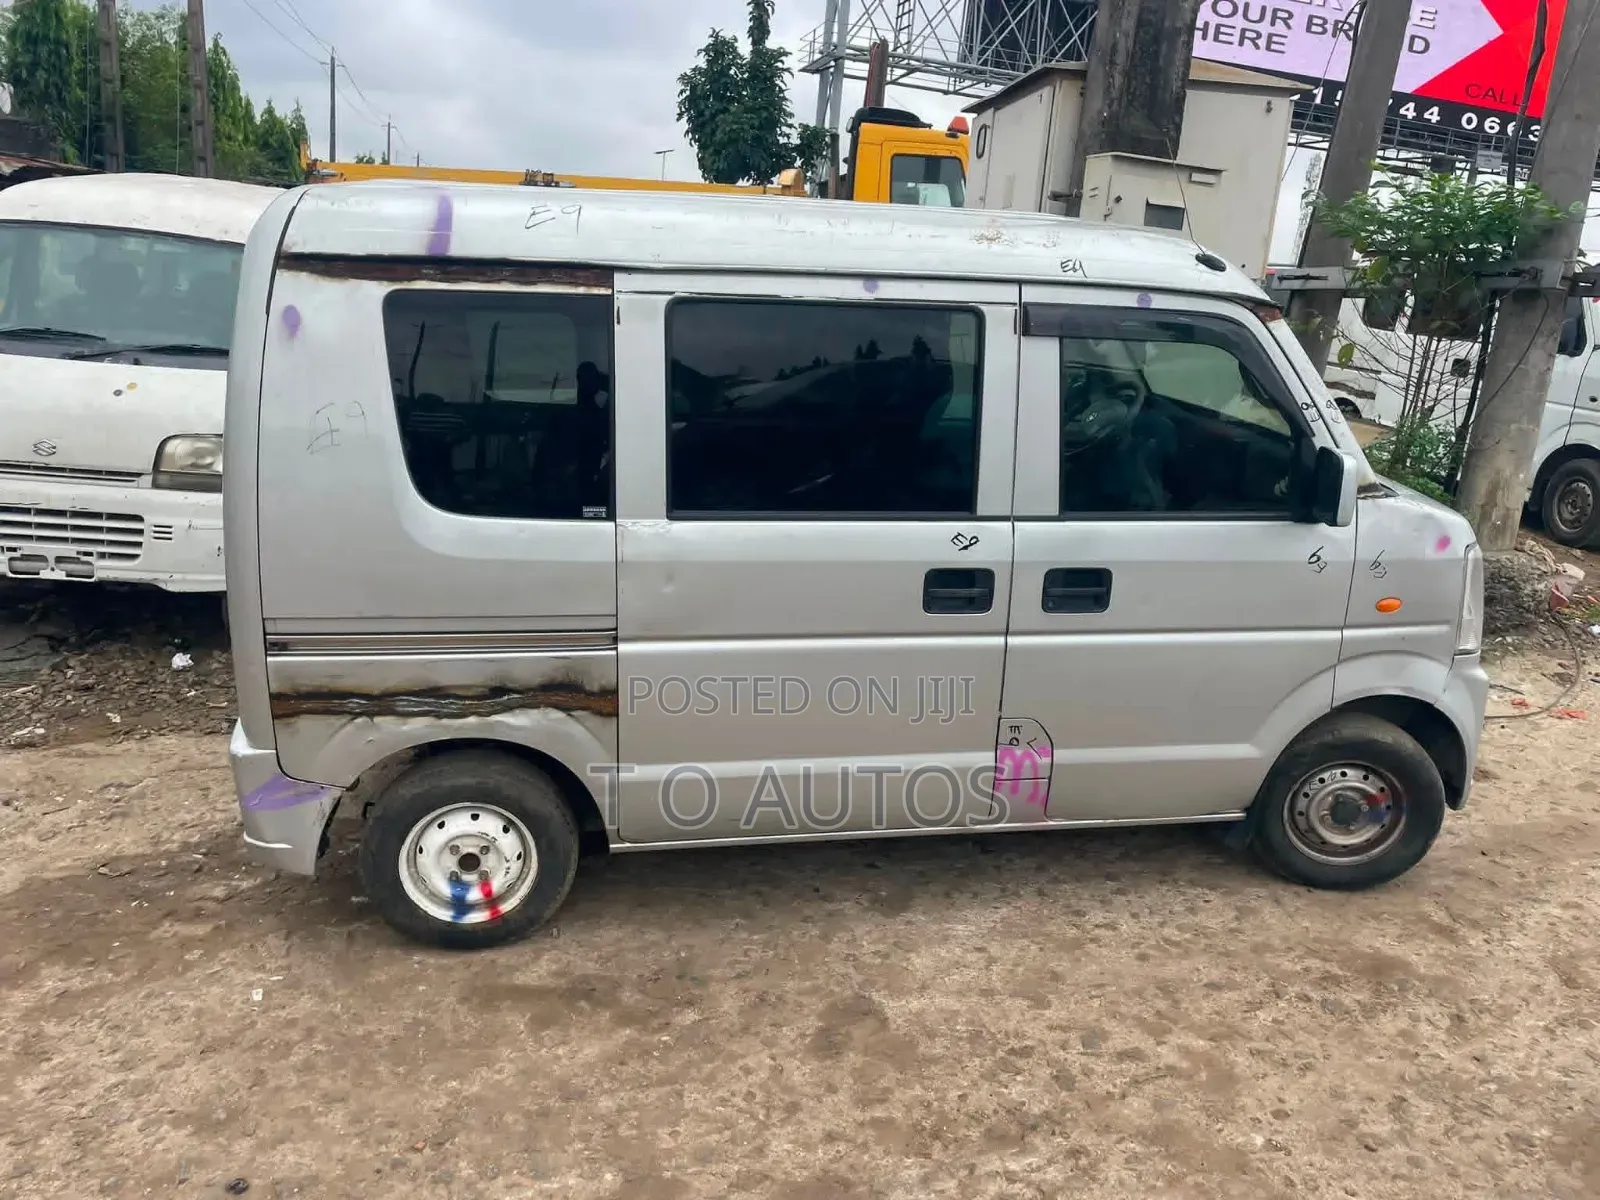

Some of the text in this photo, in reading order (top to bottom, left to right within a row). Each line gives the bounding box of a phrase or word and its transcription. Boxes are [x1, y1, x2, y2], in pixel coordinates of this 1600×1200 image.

[1200, 0, 1293, 30] OUR
[1465, 83, 1526, 107] CALL
[1388, 98, 1441, 124] 44
[524, 204, 582, 235] E9
